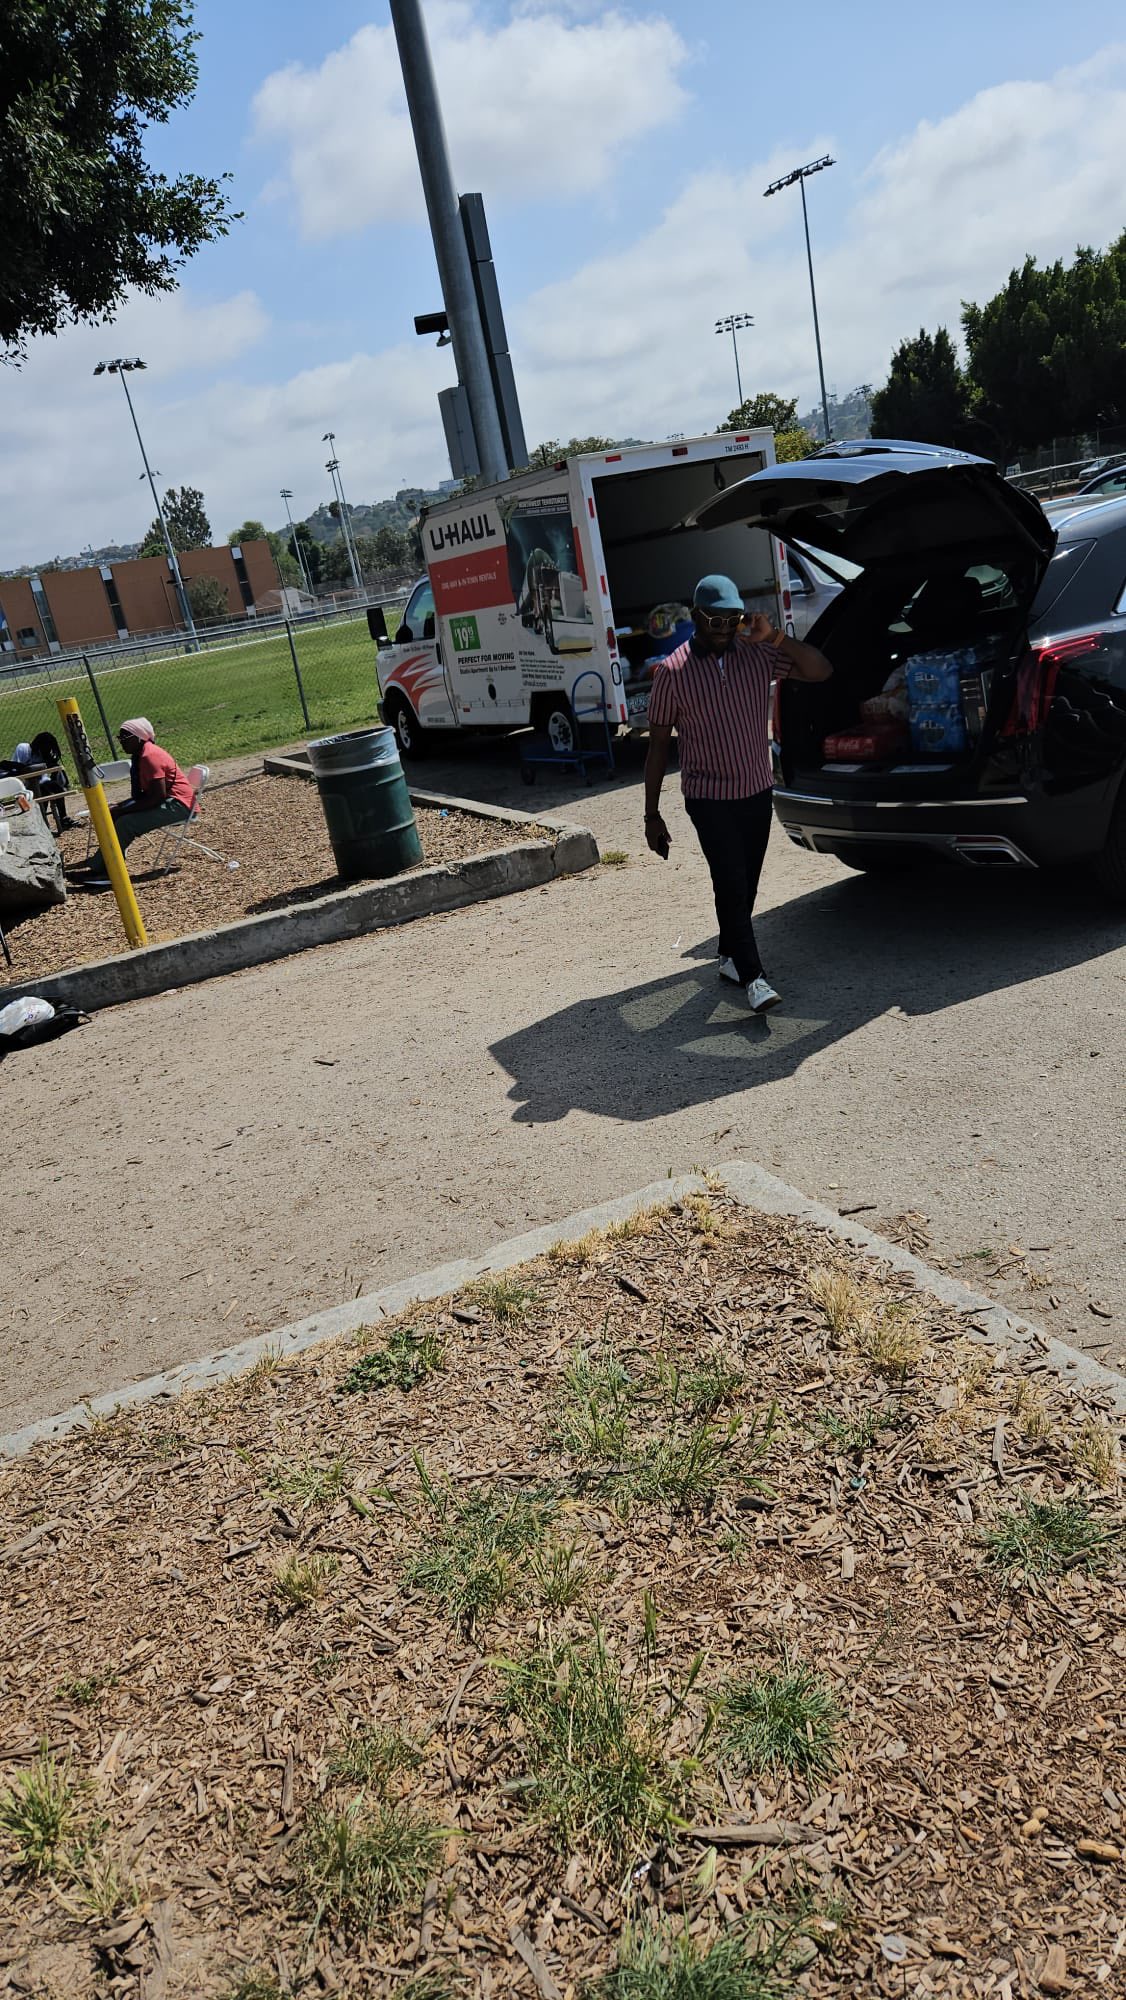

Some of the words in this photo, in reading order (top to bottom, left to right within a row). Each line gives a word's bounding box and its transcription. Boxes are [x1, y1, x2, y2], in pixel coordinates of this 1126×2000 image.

[430, 514, 496, 551] U-HAUL
[457, 655, 480, 665] PERFECT
[480, 654, 492, 662] FOR
[492, 651, 515, 661] MOVING
